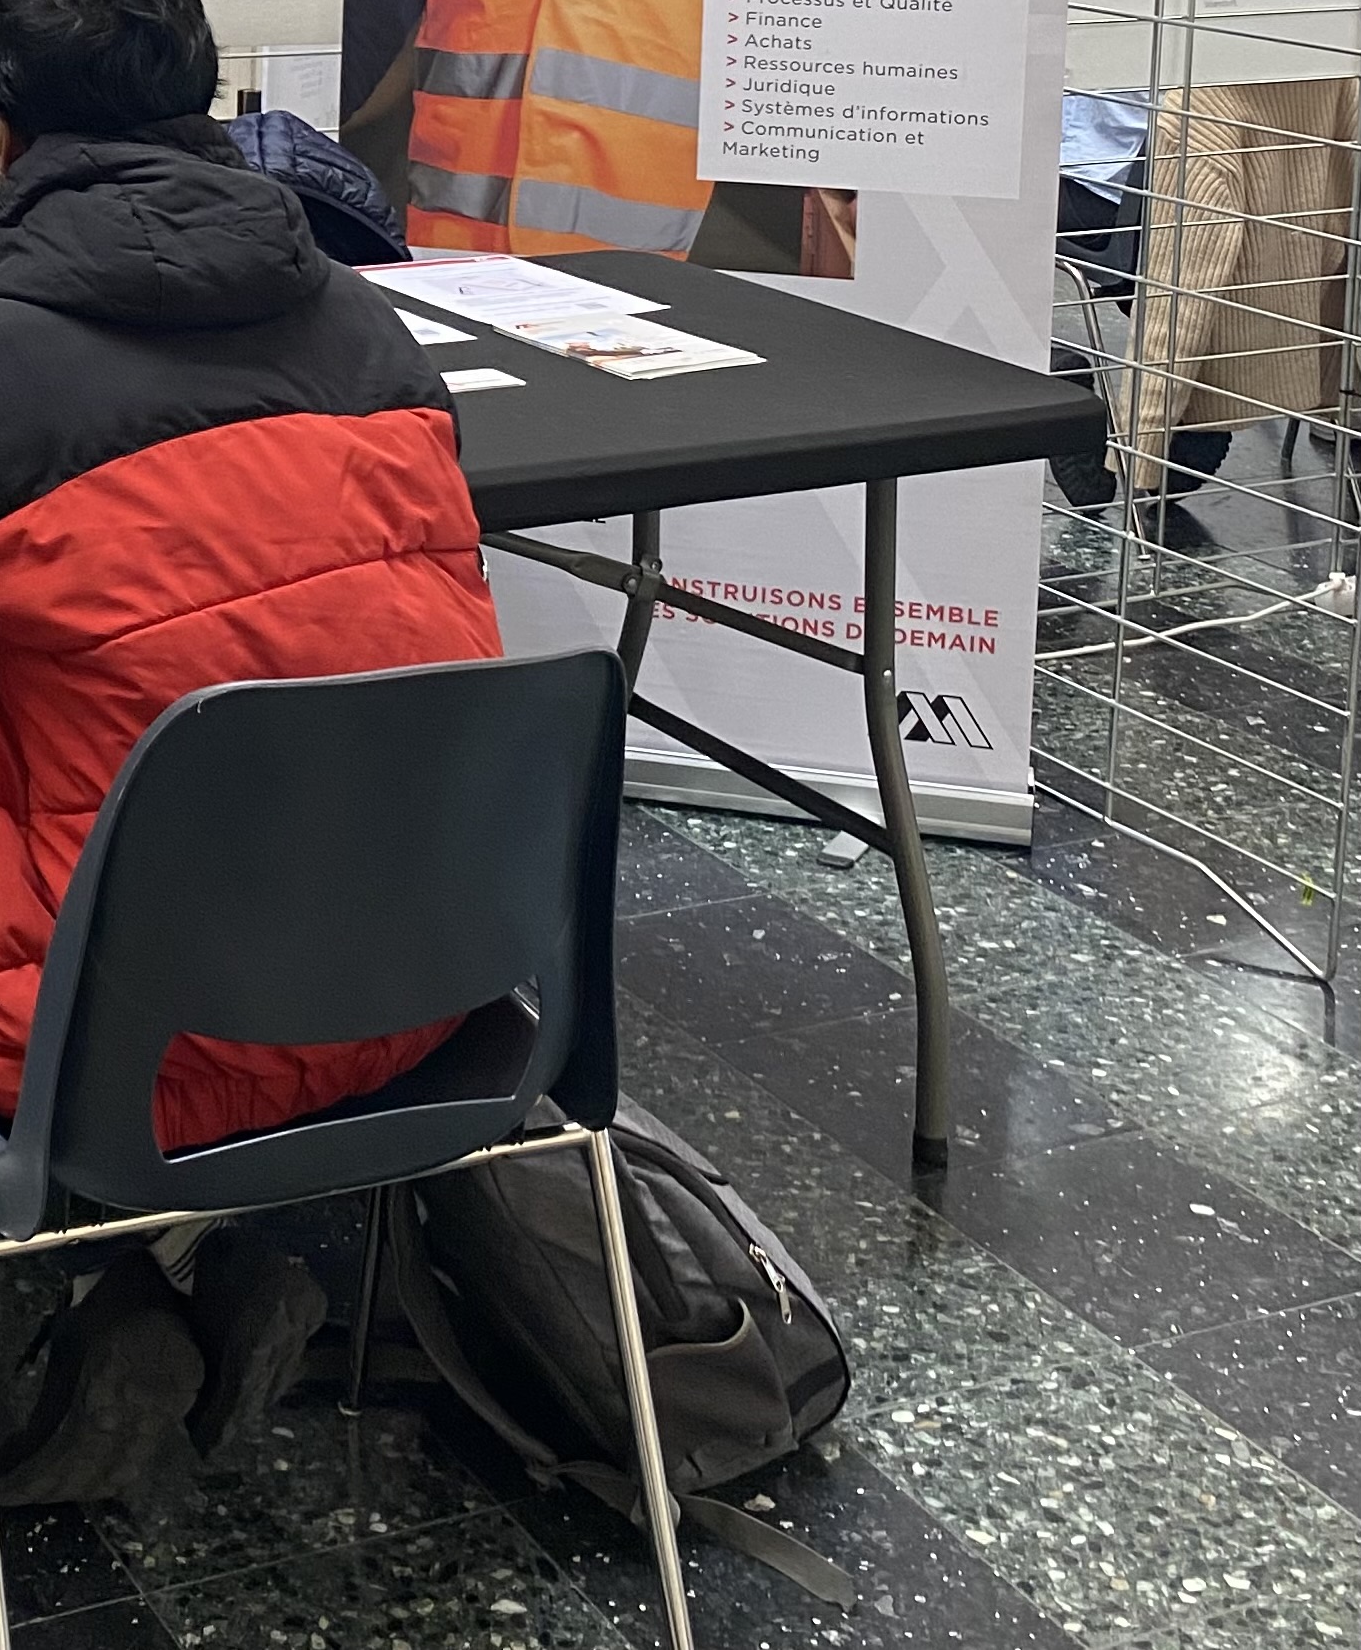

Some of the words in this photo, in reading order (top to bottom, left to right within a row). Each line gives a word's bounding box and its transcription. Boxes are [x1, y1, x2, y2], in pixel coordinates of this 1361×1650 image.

[745, 12, 823, 29] Finance
[744, 34, 813, 51] Achats
[744, 56, 855, 75] Ressources
[863, 61, 958, 80] humaines
[743, 78, 836, 97] Juridique
[741, 100, 835, 119] Systèmes
[741, 121, 897, 144] Communication
[905, 131, 925, 145] et
[722, 142, 821, 163] Marketing
[671, 577, 842, 610] NSTRUISONS
[854, 596, 999, 627] ESEMBLE
